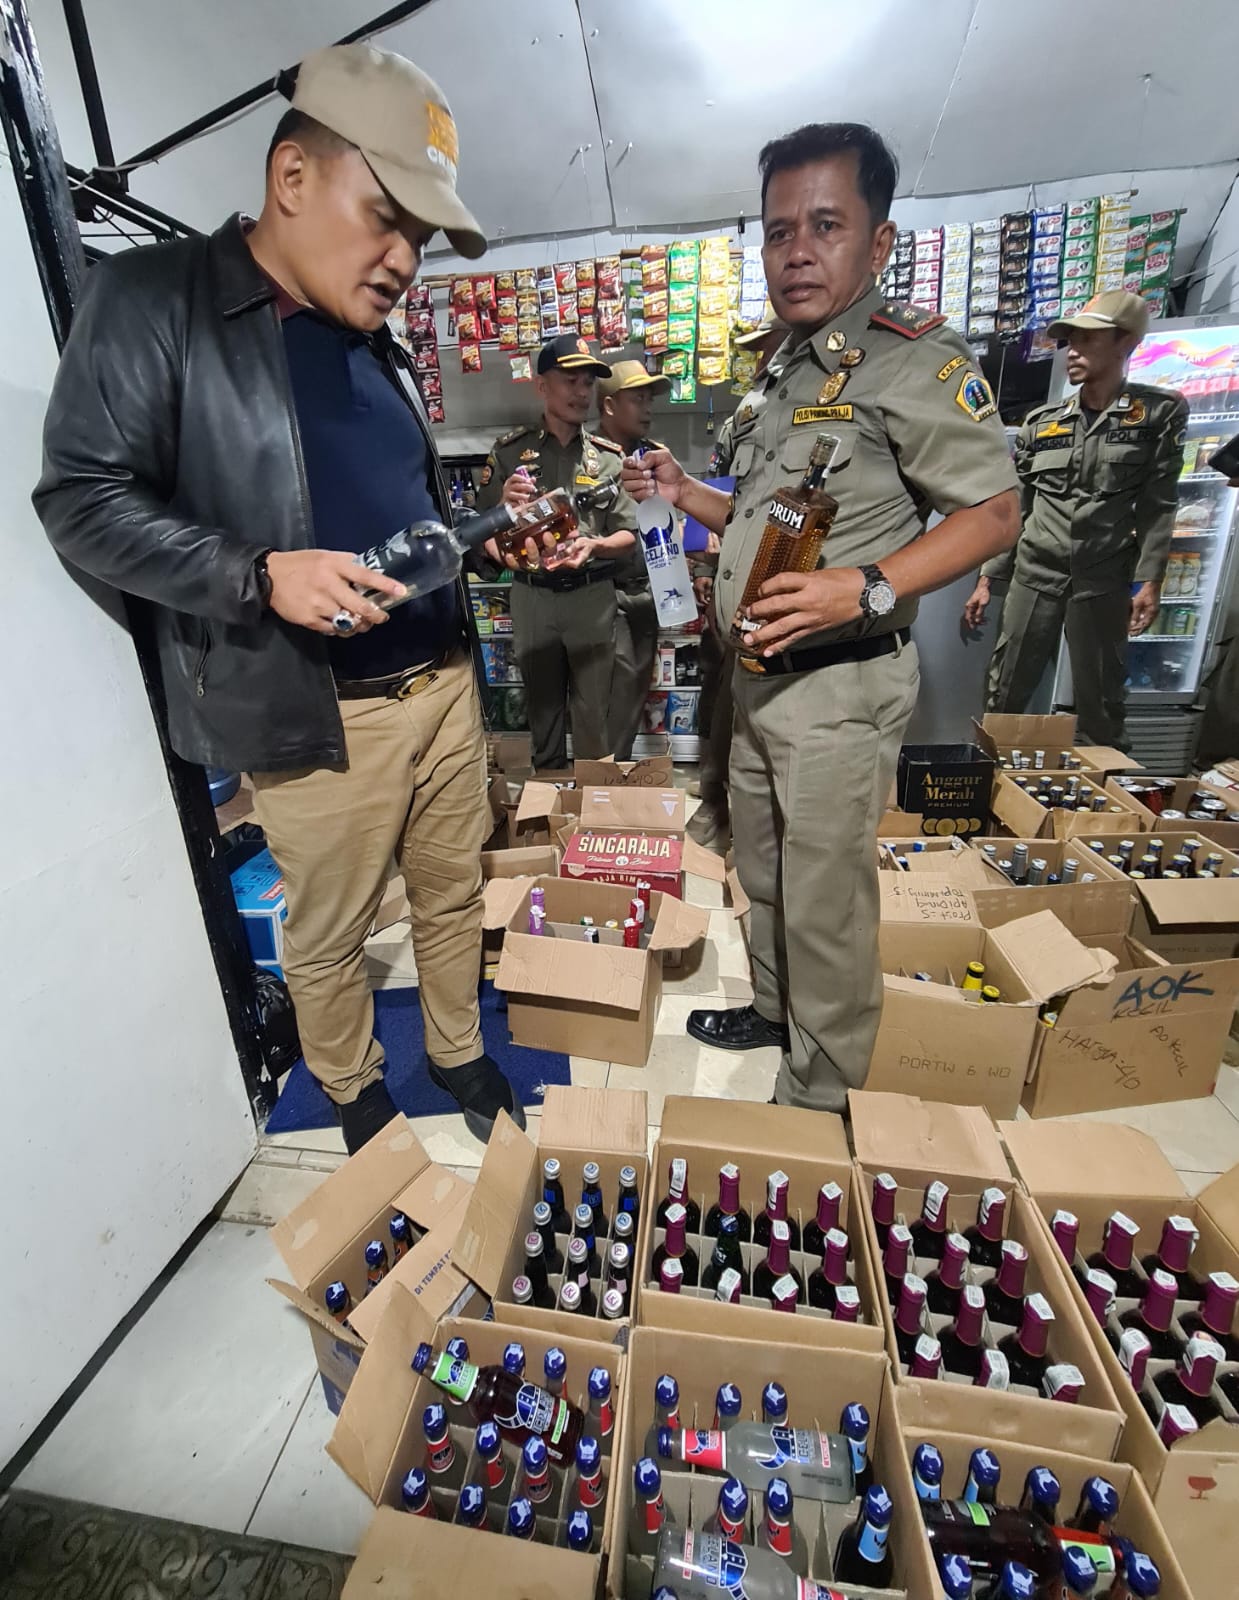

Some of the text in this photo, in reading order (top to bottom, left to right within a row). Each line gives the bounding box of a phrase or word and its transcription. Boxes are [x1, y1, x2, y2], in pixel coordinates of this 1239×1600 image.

[1109, 430, 1135, 441] POL
[921, 772, 983, 788] Anggur
[924, 786, 976, 800] Merah
[578, 836, 671, 858] SINGARAJA
[414, 1257, 447, 1296] DI TEMPAT
